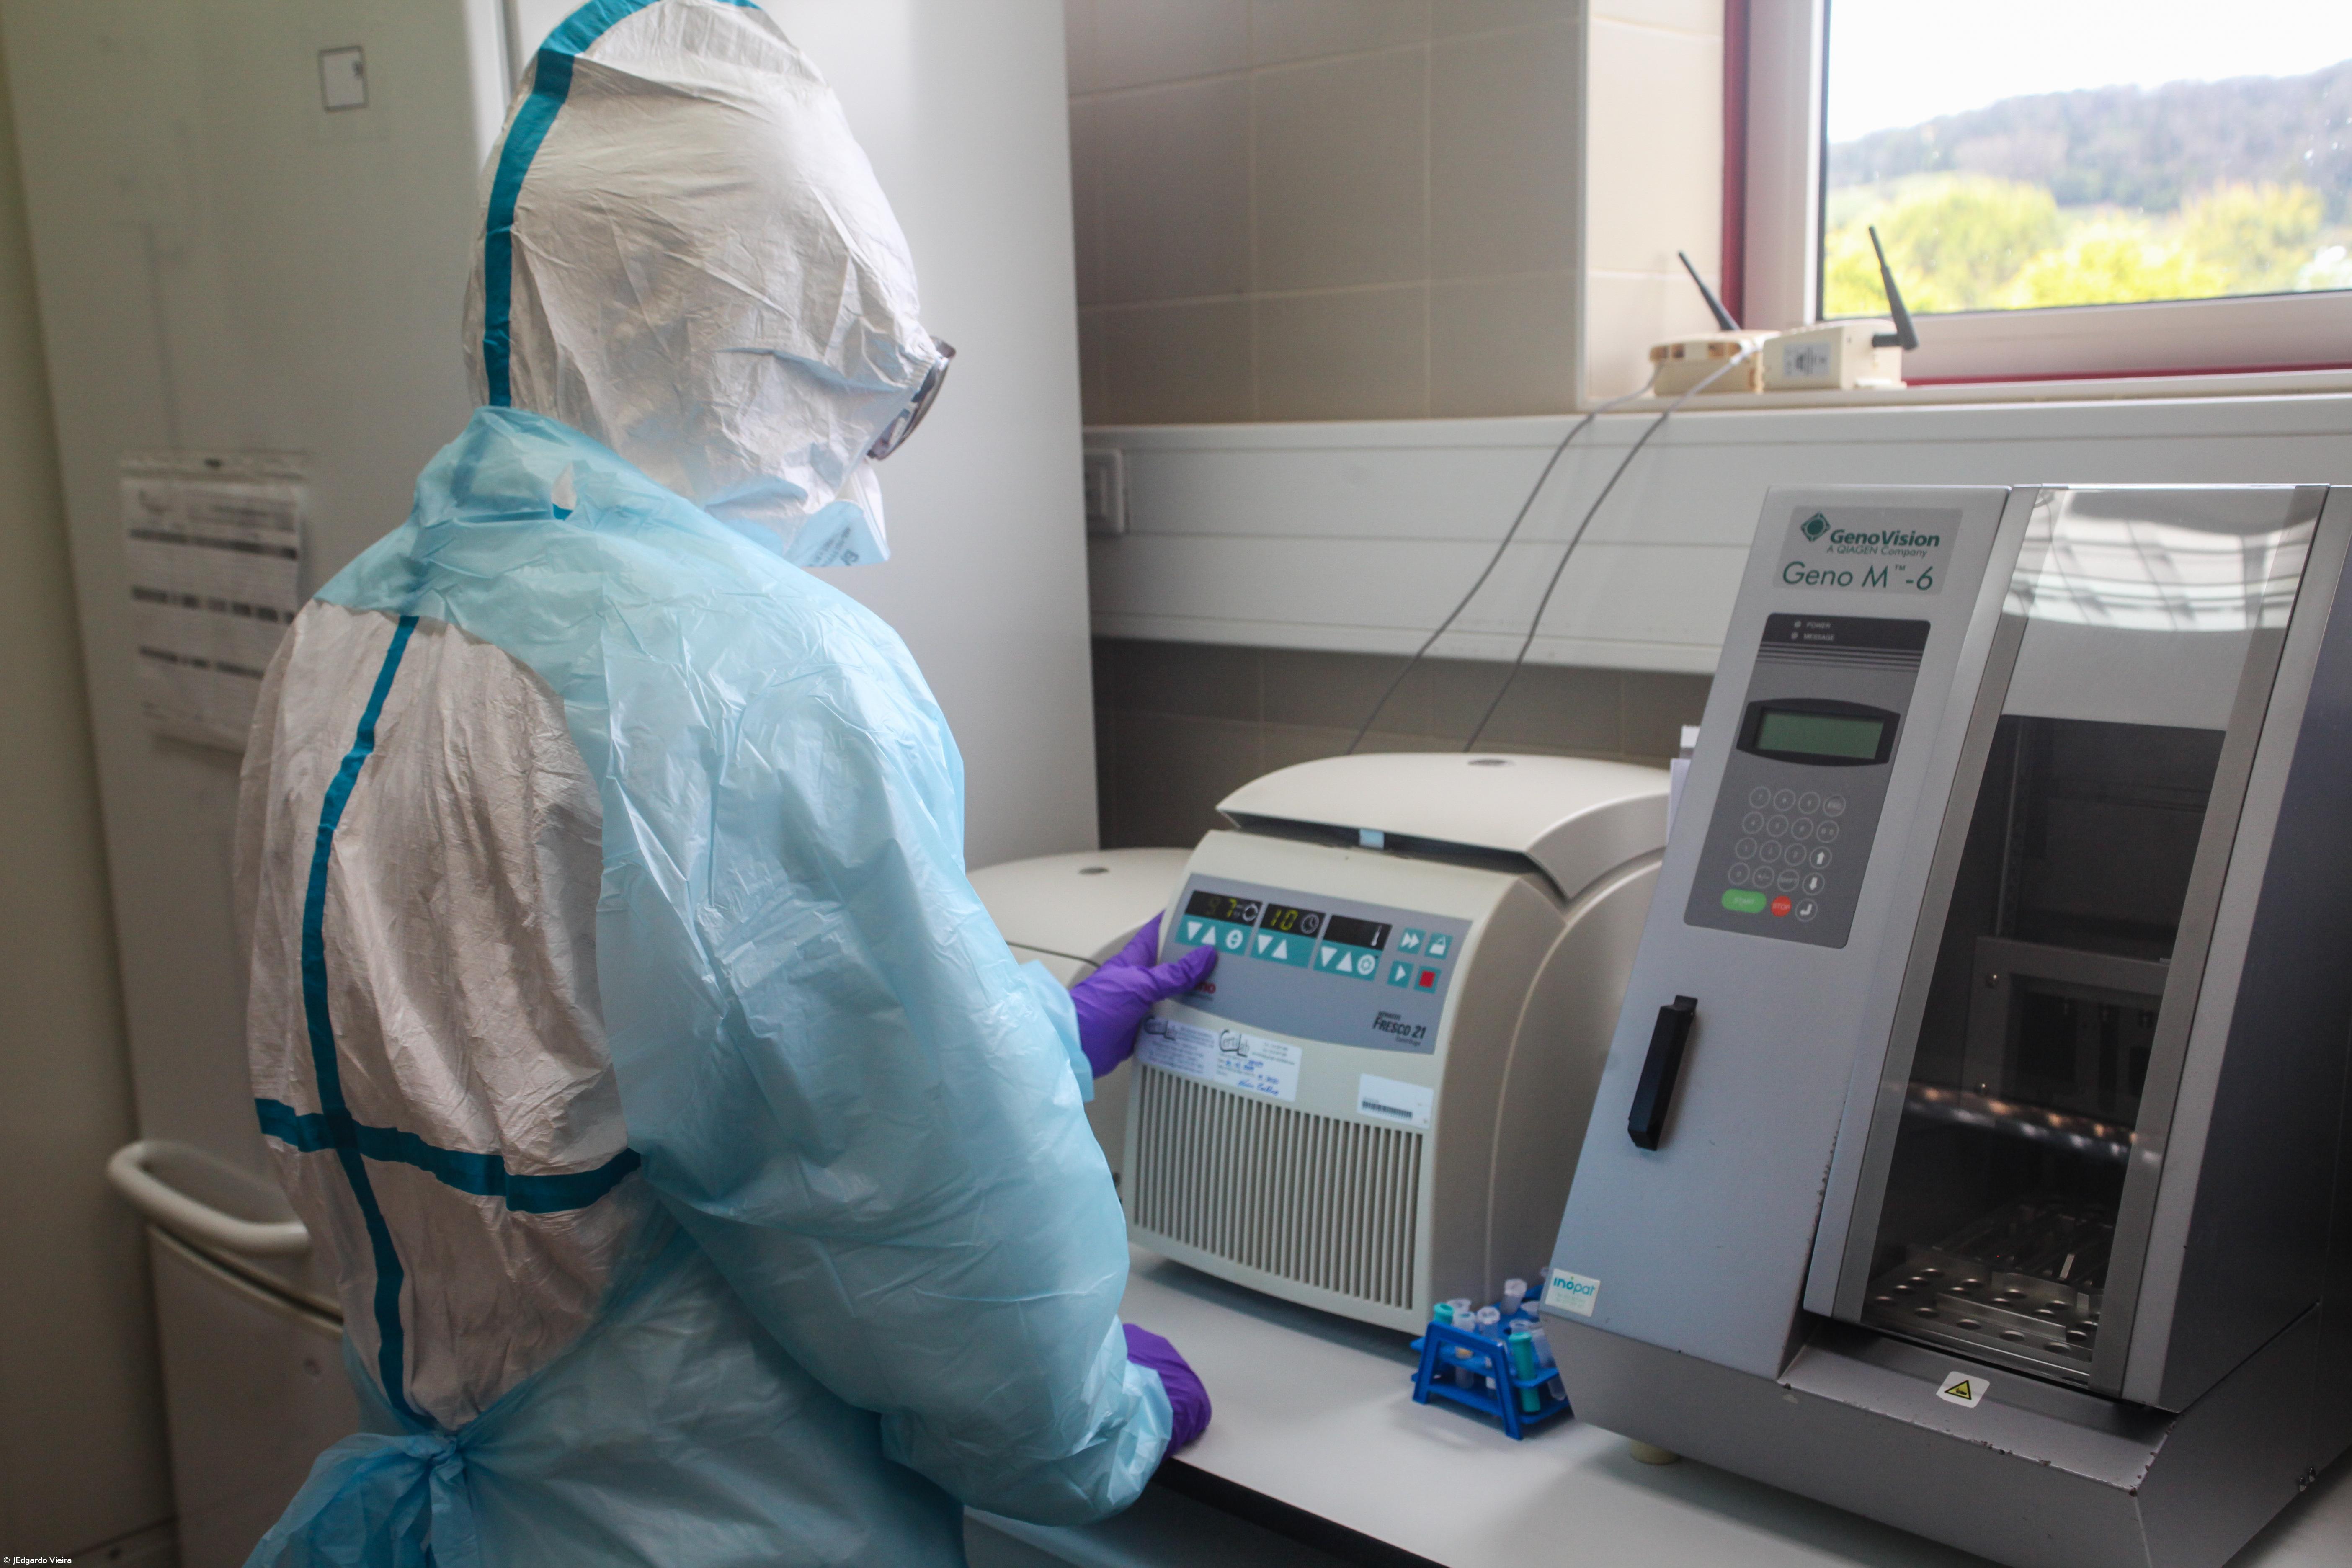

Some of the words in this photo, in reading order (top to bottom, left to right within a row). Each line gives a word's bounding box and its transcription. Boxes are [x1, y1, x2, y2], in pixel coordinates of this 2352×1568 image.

[1831, 529, 1940, 547] GenoVision
[1837, 545, 1878, 555] QIAGEN
[1881, 547, 1927, 558] Company
[1783, 561, 1853, 587] Geno
[1271, 908, 1299, 931] 10
[1372, 1016, 1412, 1036] FRESCO
[1412, 1025, 1427, 1039] 21
[1553, 1277, 1595, 1296] inopat
